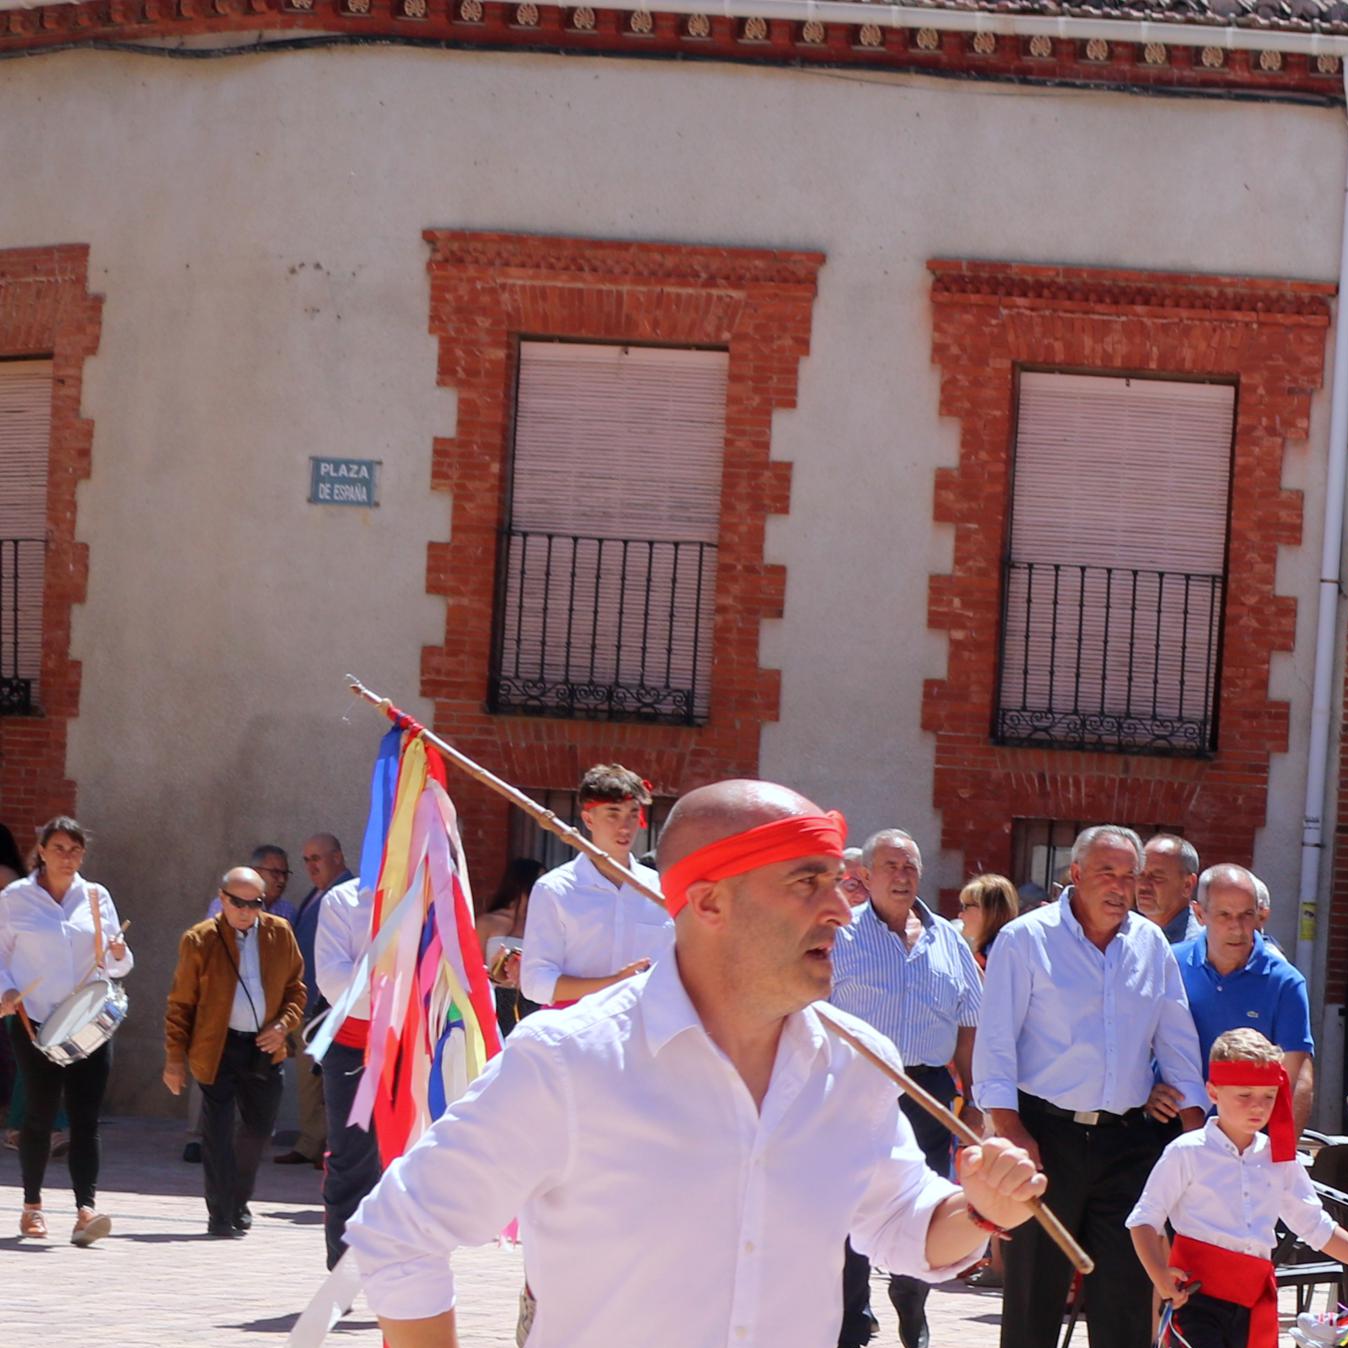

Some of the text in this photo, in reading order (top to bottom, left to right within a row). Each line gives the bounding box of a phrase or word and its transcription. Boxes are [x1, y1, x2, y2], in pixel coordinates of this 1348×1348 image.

[320, 462, 369, 478] PLAZA
[319, 482, 368, 502] DE ESPAÑA
